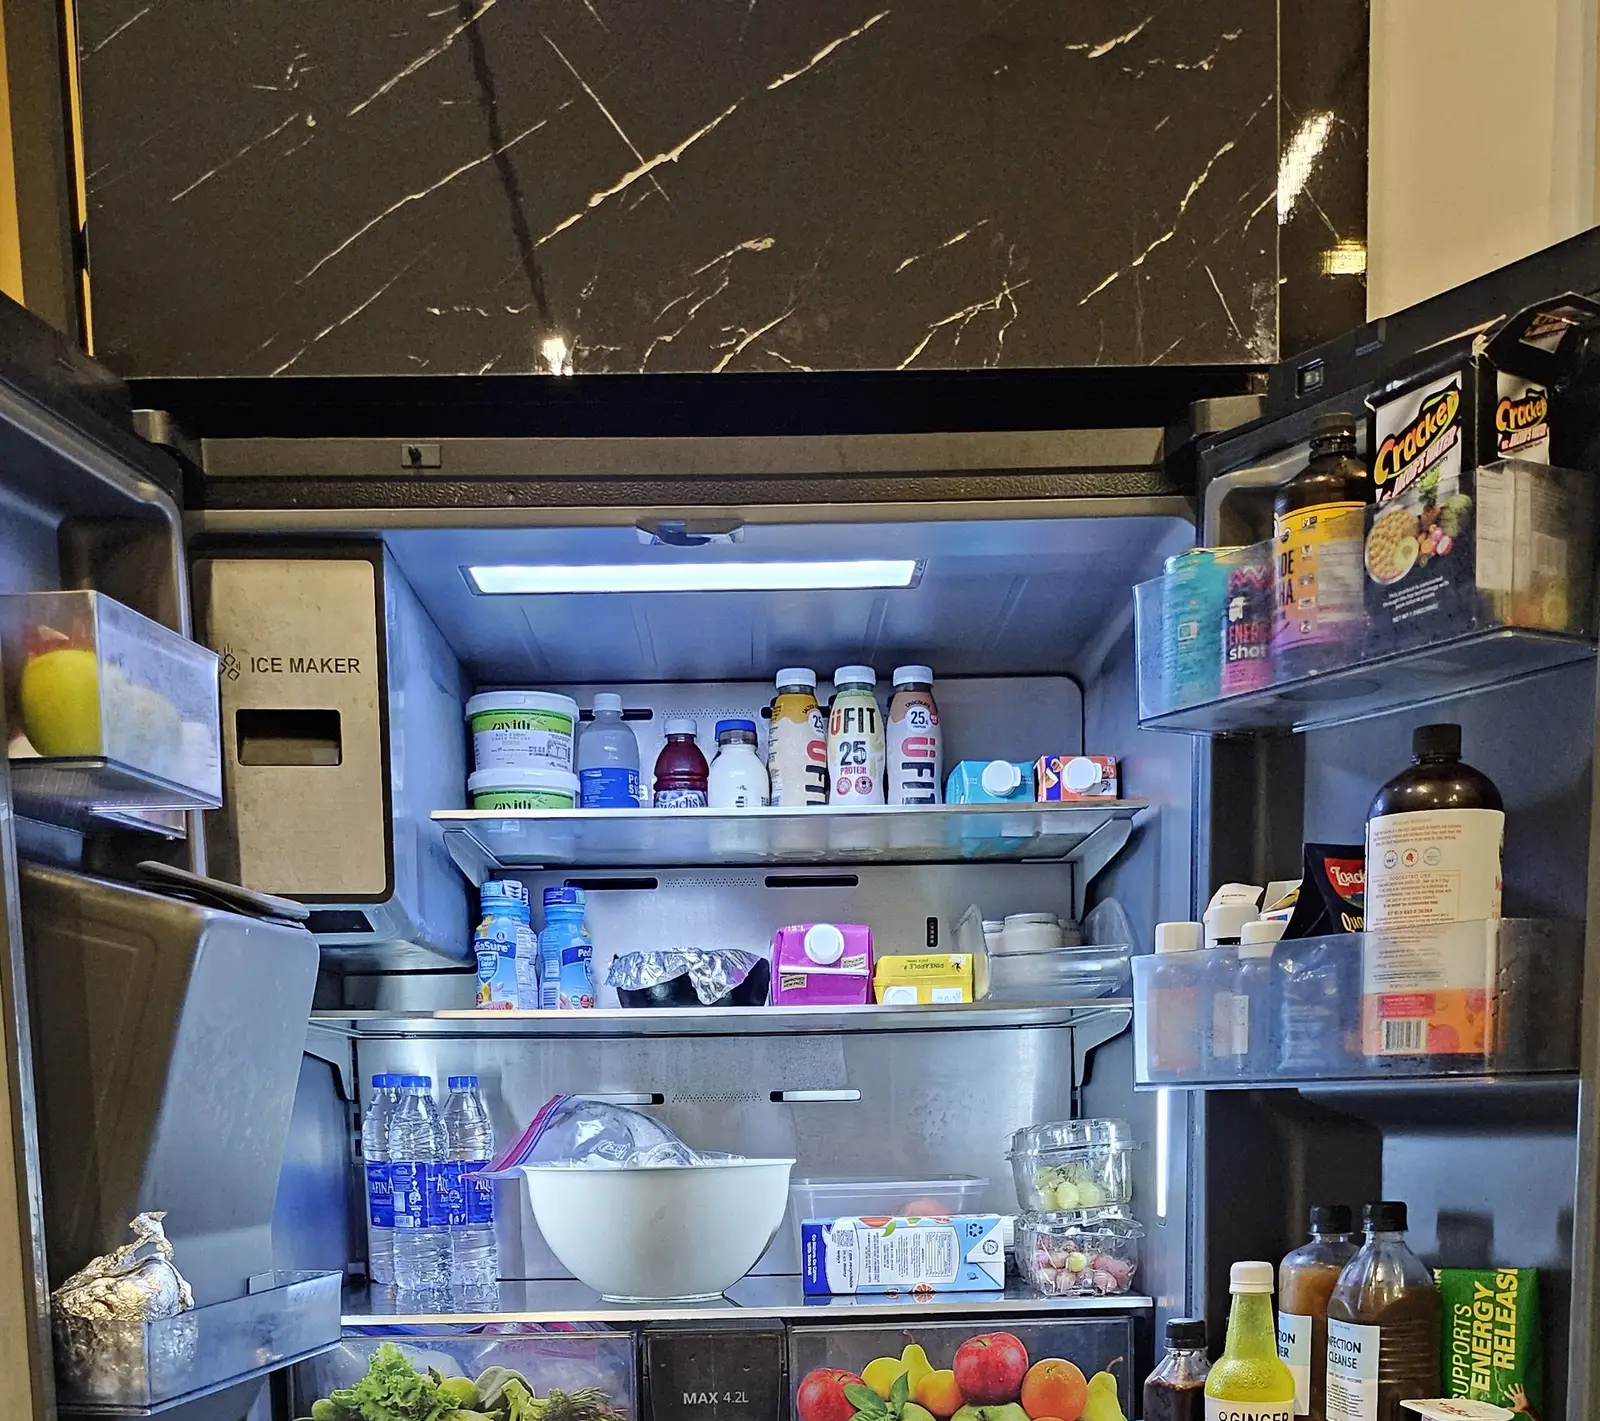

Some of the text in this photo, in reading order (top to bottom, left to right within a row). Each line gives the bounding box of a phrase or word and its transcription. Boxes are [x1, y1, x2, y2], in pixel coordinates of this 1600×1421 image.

[251, 658, 361, 673] ICE MAKER
[1471, 1281, 1494, 1391] ENERGY
[1328, 1350, 1358, 1369] CLEANSE
[683, 1391, 749, 1405] MAX 4.2L
